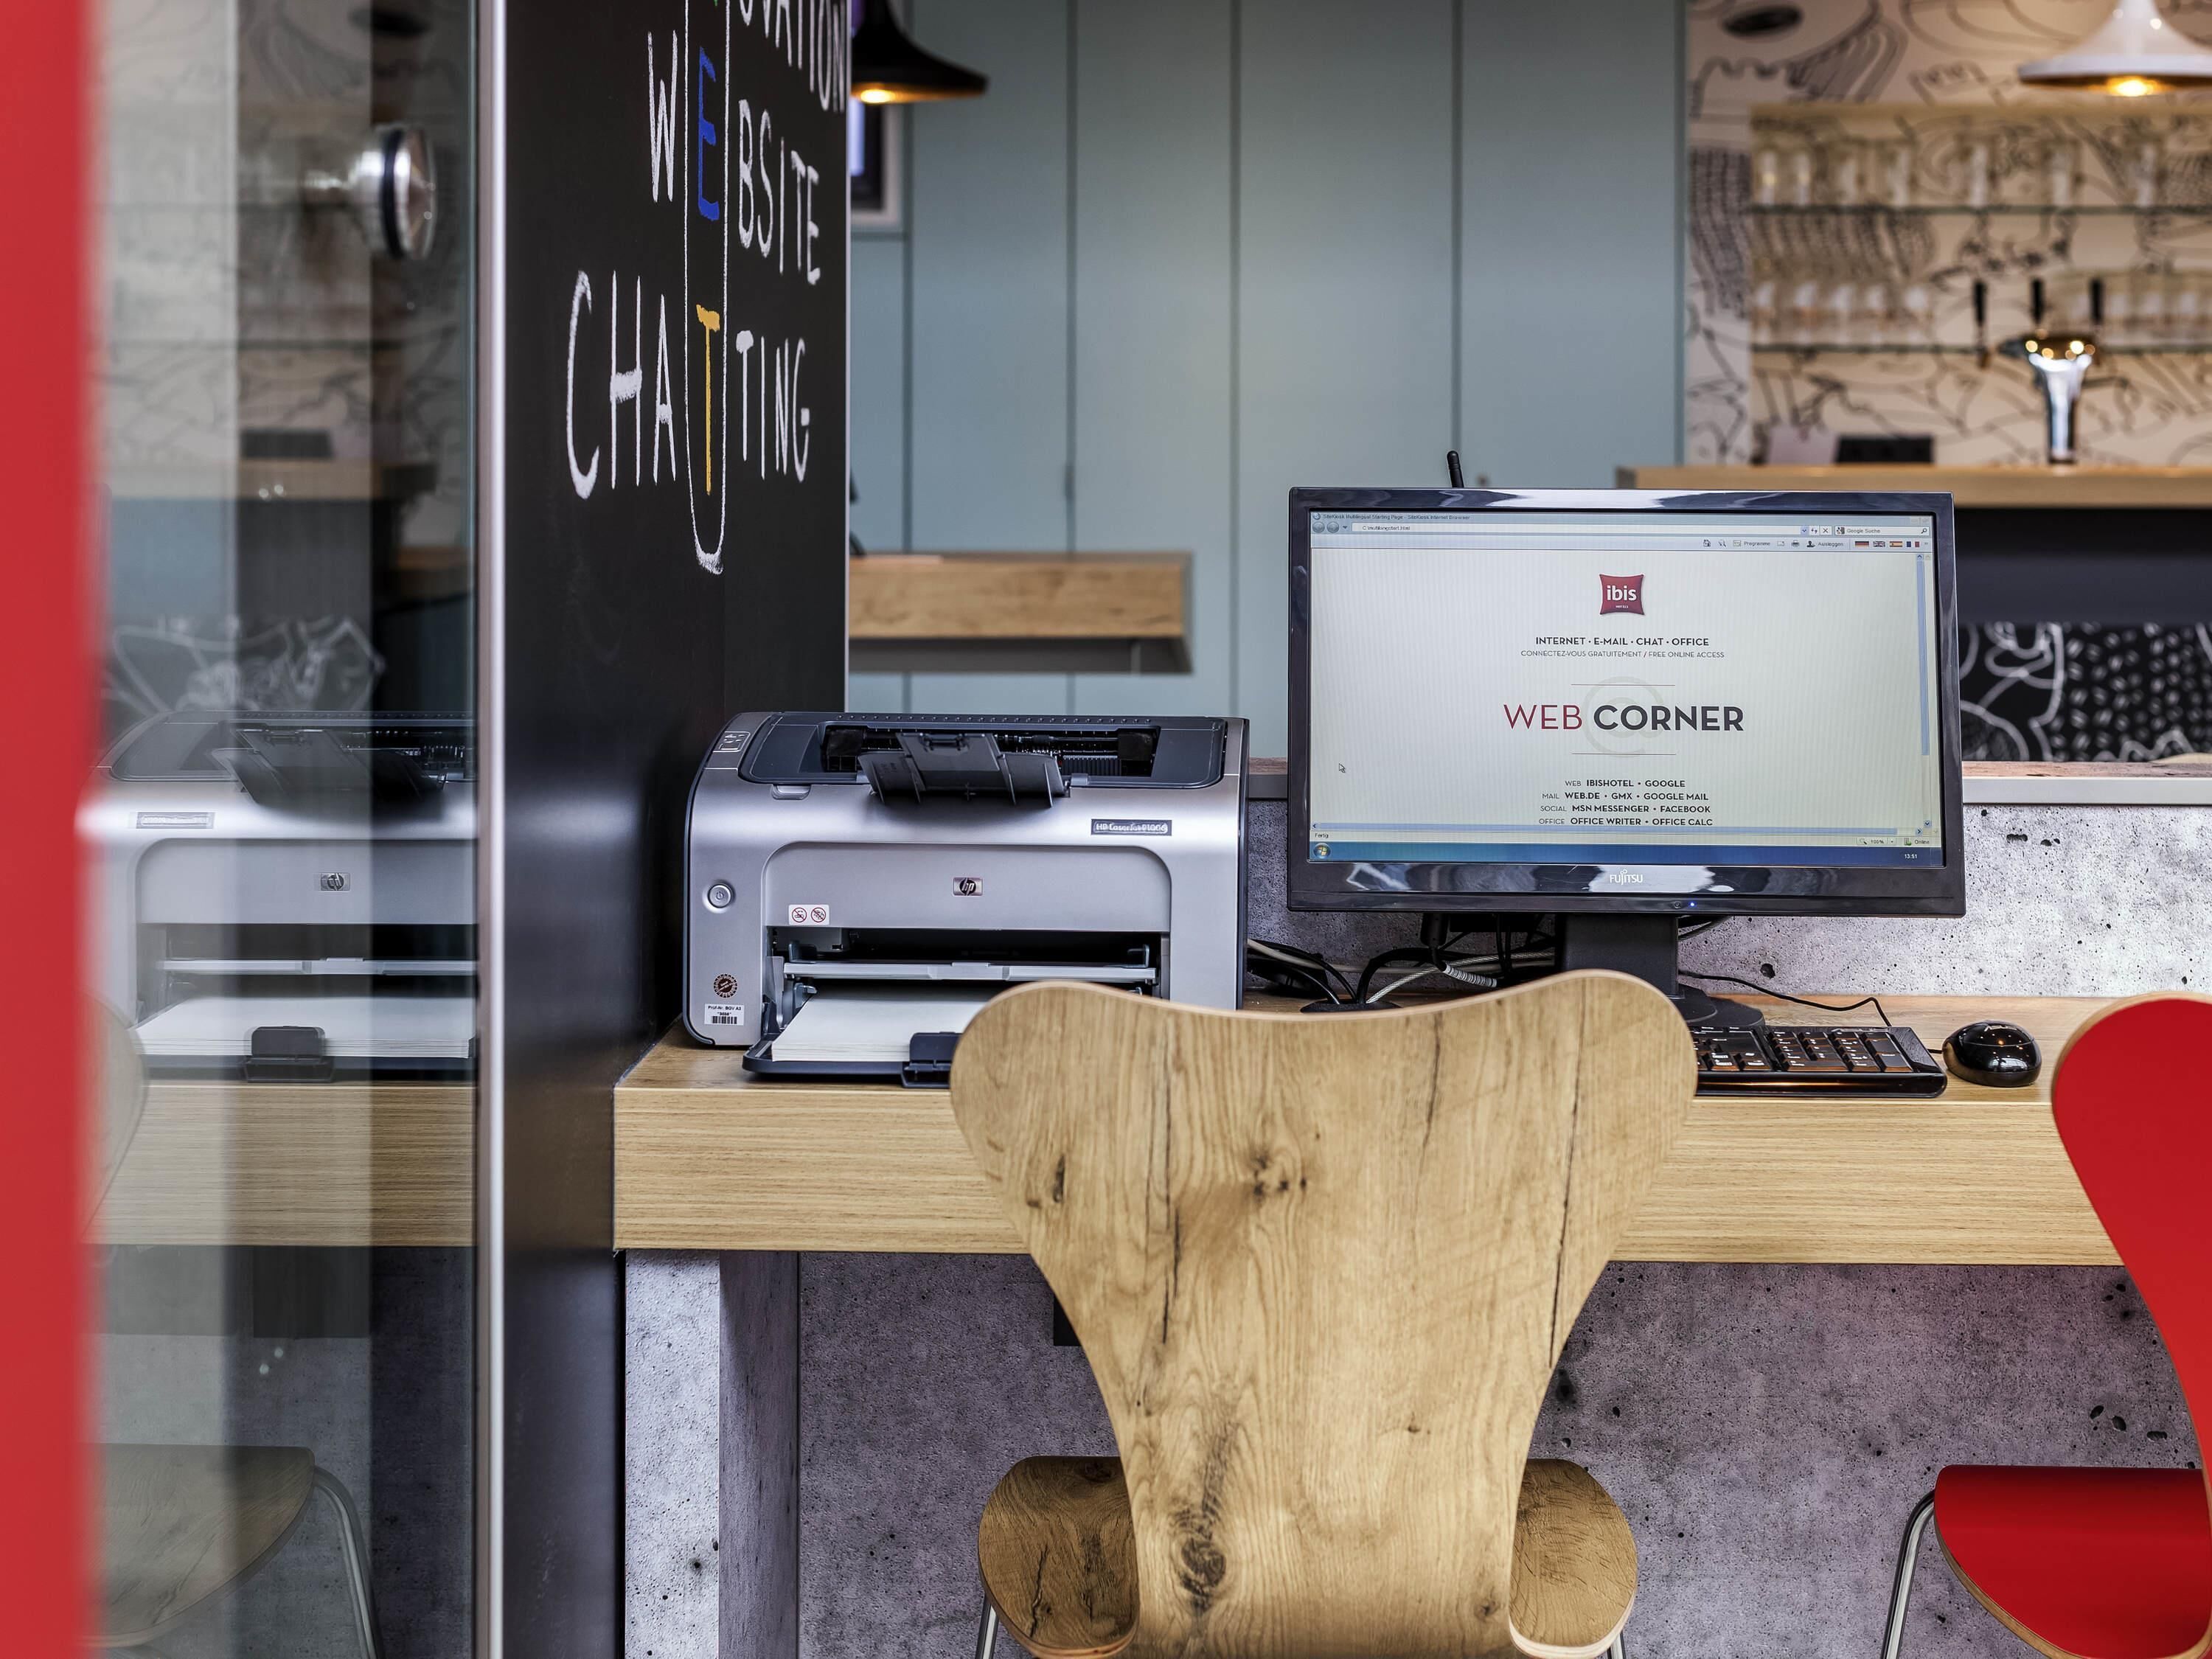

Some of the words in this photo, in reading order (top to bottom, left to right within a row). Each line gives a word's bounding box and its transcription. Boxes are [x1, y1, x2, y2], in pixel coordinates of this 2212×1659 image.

[647, 30, 820, 285] WEBSITE
[567, 270, 810, 499] CHATTING
[1607, 585, 1637, 601] ibis
[1535, 636, 1585, 645] INTERNET
[1593, 637, 1628, 646] E-MAIL
[1635, 637, 1663, 647] CHAT
[1672, 638, 1709, 647] OFFICE
[1503, 704, 1582, 730] WEB
[1593, 705, 1744, 731] CORNER
[1586, 779, 1634, 787] IBISHOTEL
[1606, 818, 1641, 826] WRITER
[961, 877, 975, 895] hp
[1610, 869, 1644, 886] FUJITSU
